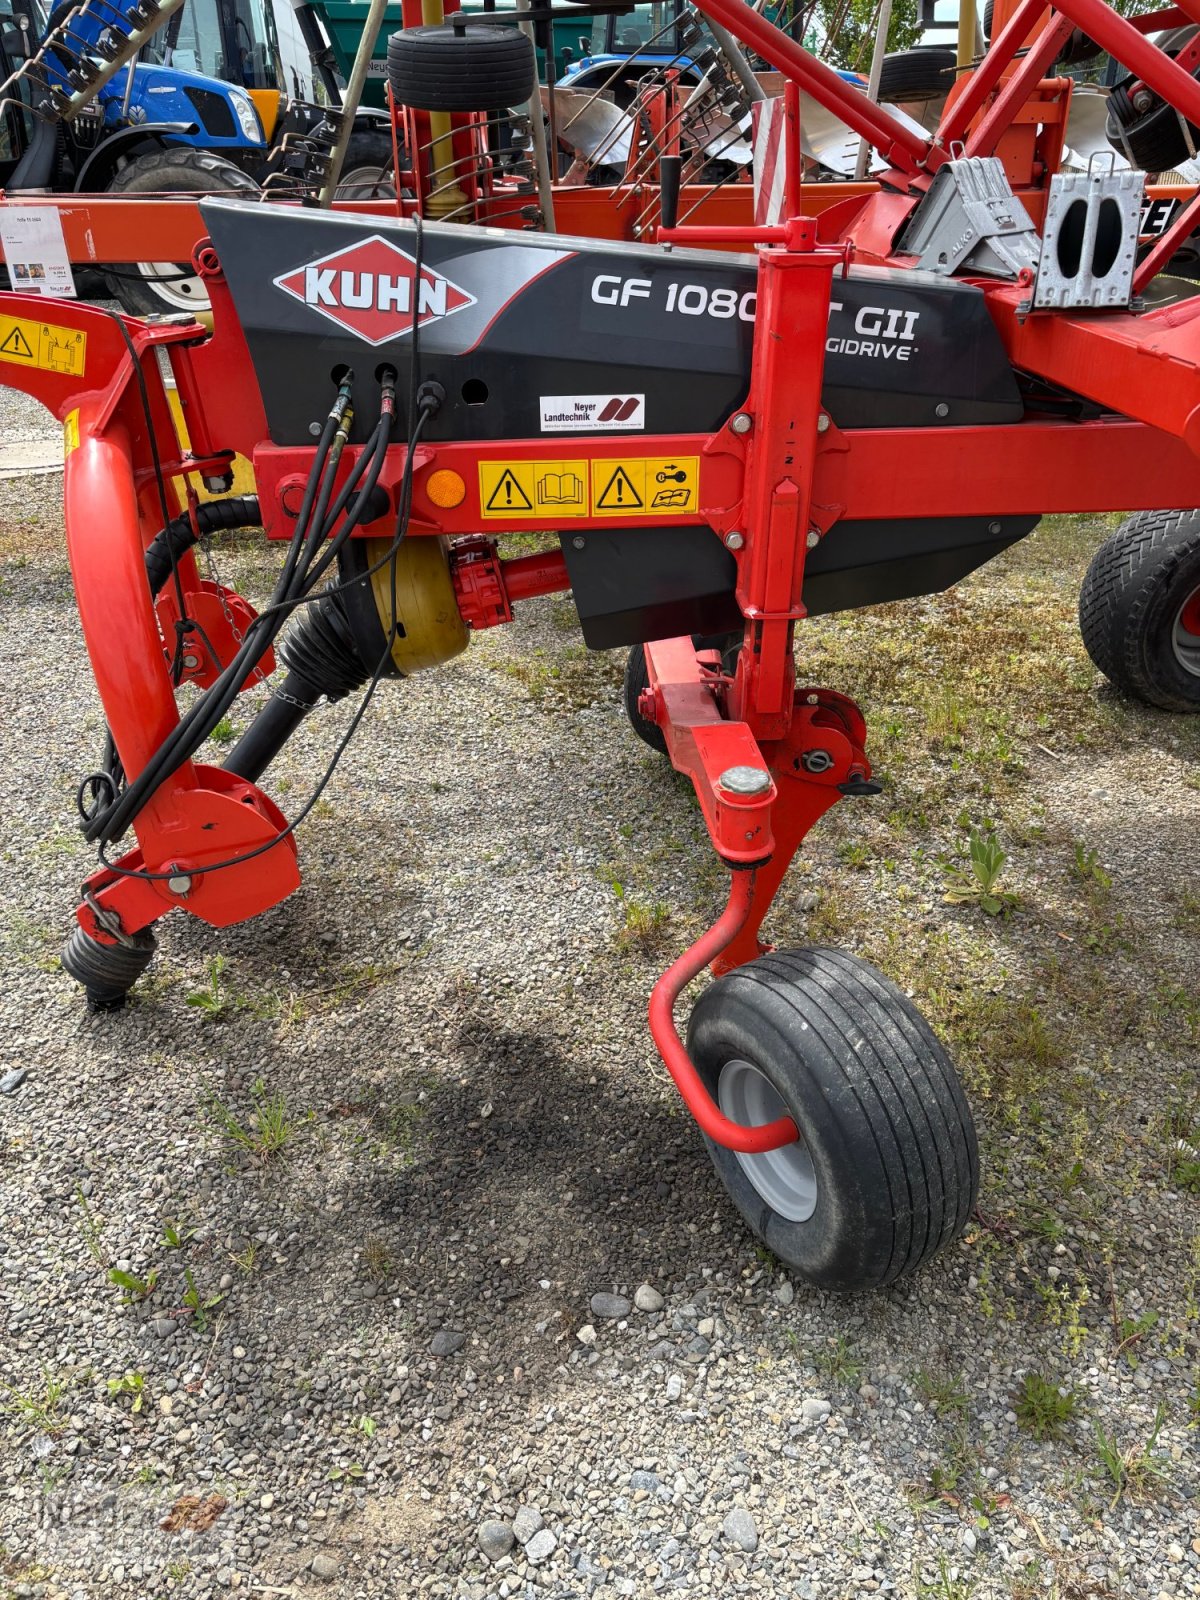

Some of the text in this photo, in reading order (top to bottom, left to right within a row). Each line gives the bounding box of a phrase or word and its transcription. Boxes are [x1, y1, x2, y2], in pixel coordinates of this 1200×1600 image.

[305, 266, 447, 316] KUHN
[591, 275, 652, 307] GF
[855, 306, 920, 340] GII
[825, 337, 912, 361] GIDRIVE
[544, 413, 591, 422] Landtechnik
[574, 402, 596, 412] Neyer
